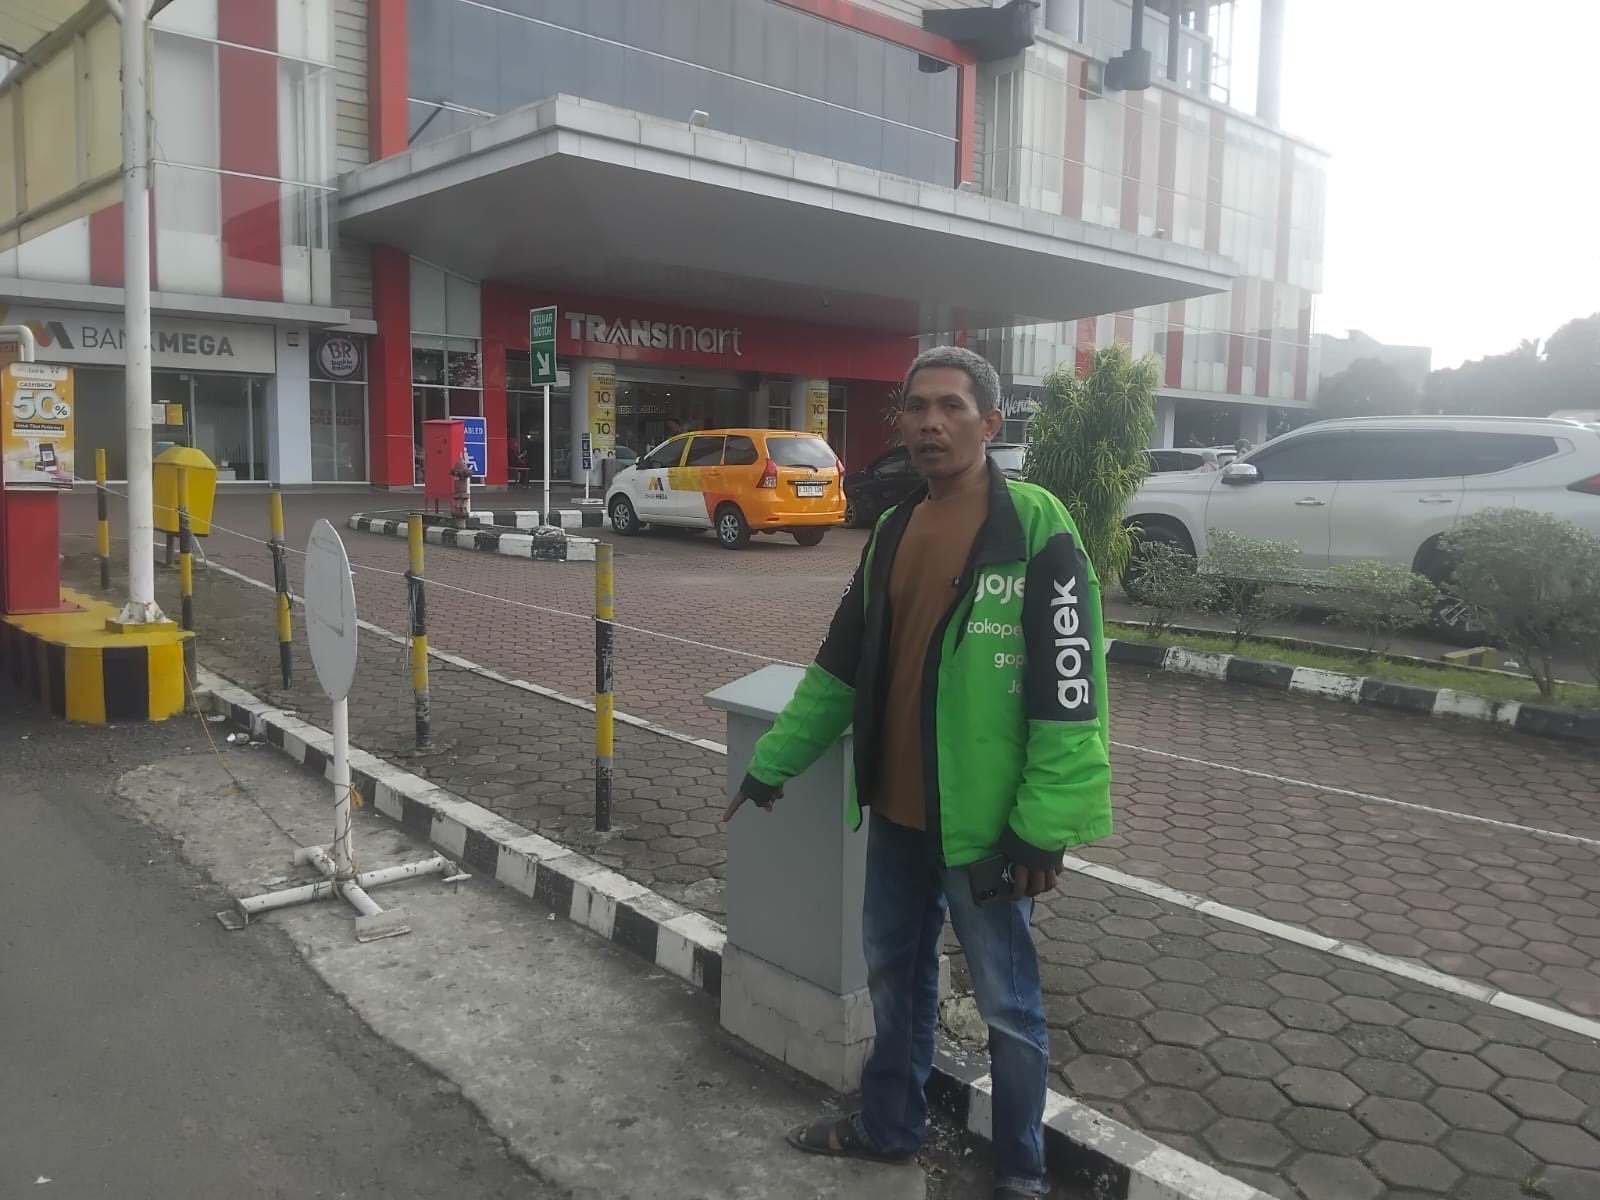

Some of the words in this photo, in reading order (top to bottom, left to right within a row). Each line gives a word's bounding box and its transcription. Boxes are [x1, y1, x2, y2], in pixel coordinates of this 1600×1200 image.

[533, 313, 553, 325] KELUAR
[533, 326, 552, 337] MOTOR
[158, 331, 234, 356] MEGA
[565, 312, 742, 356] TRANSmart
[328, 341, 352, 359] BR
[13, 391, 69, 420] 50%
[1051, 576, 1090, 709] gojek
